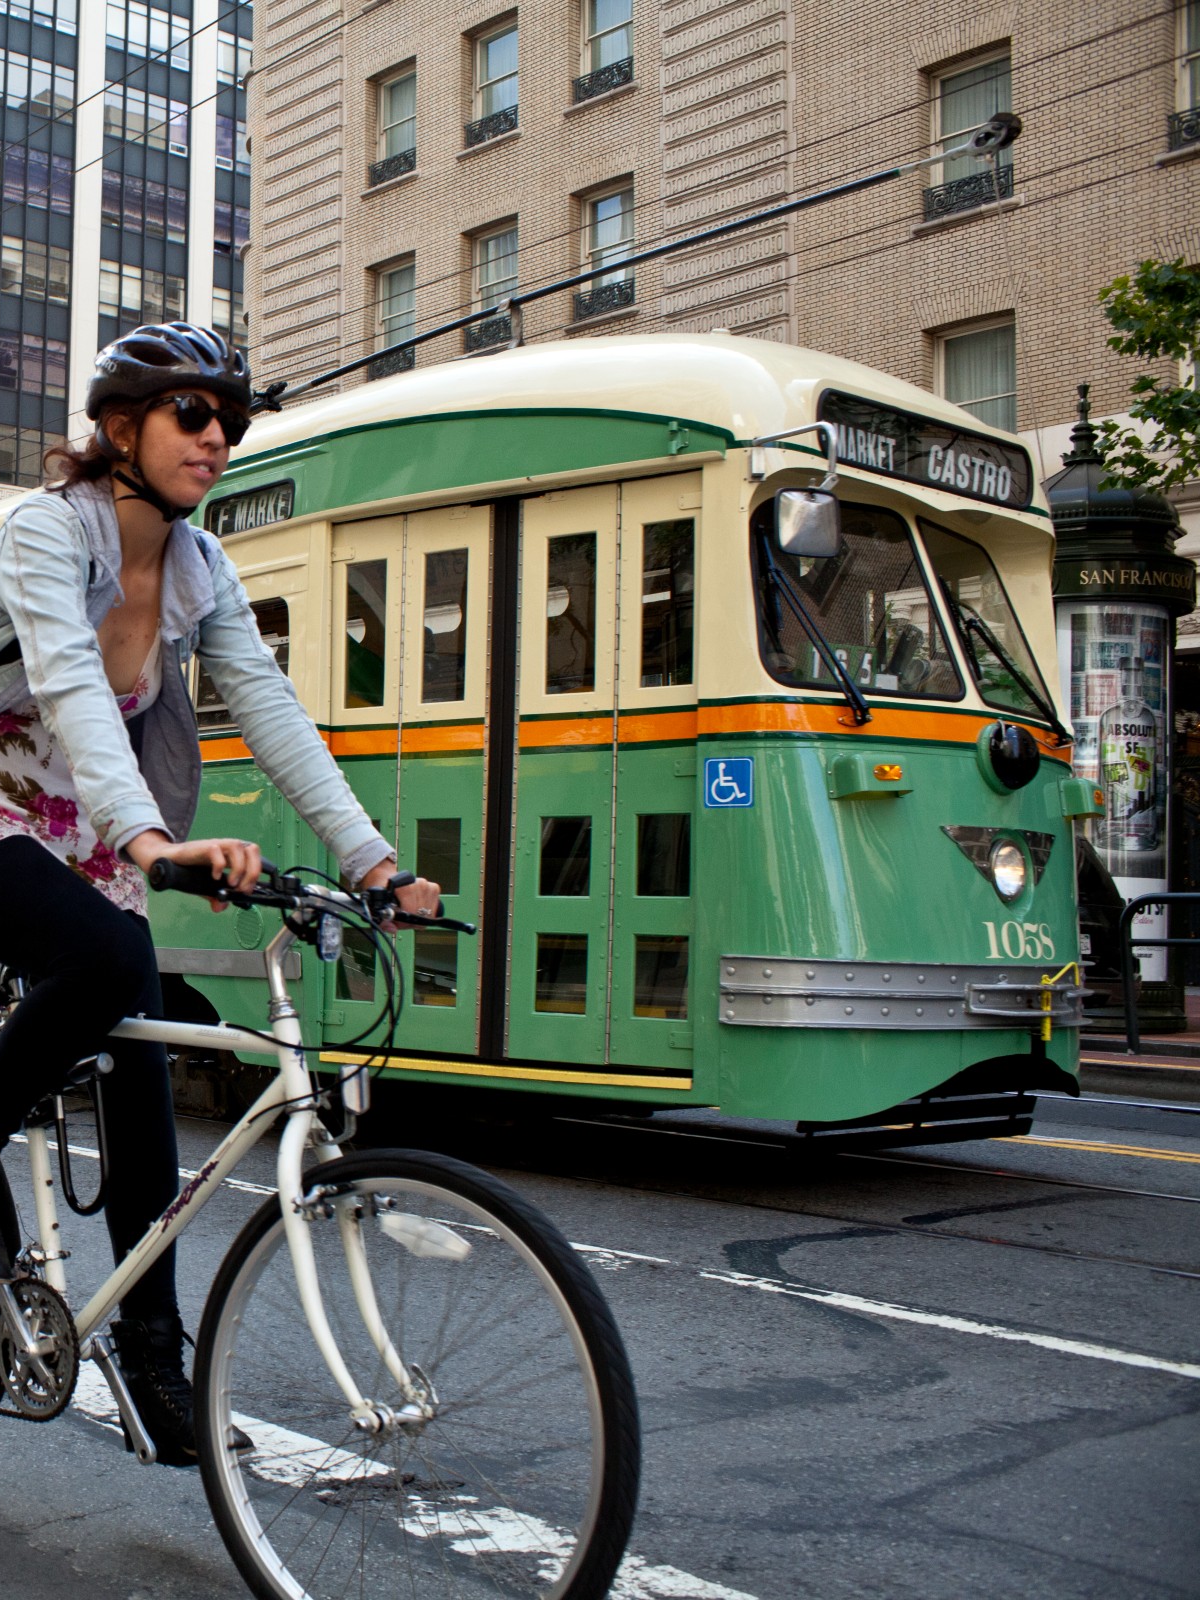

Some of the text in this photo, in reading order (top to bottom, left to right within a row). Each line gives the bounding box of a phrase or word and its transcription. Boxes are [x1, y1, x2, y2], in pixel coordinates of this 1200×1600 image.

[833, 422, 1012, 501] MARKET CASTRO
[218, 503, 230, 536] F
[1080, 569, 1115, 585] SAN
[1108, 723, 1153, 738] ABSOLUT
[1125, 741, 1140, 754] SF
[981, 920, 1056, 961] 1058
